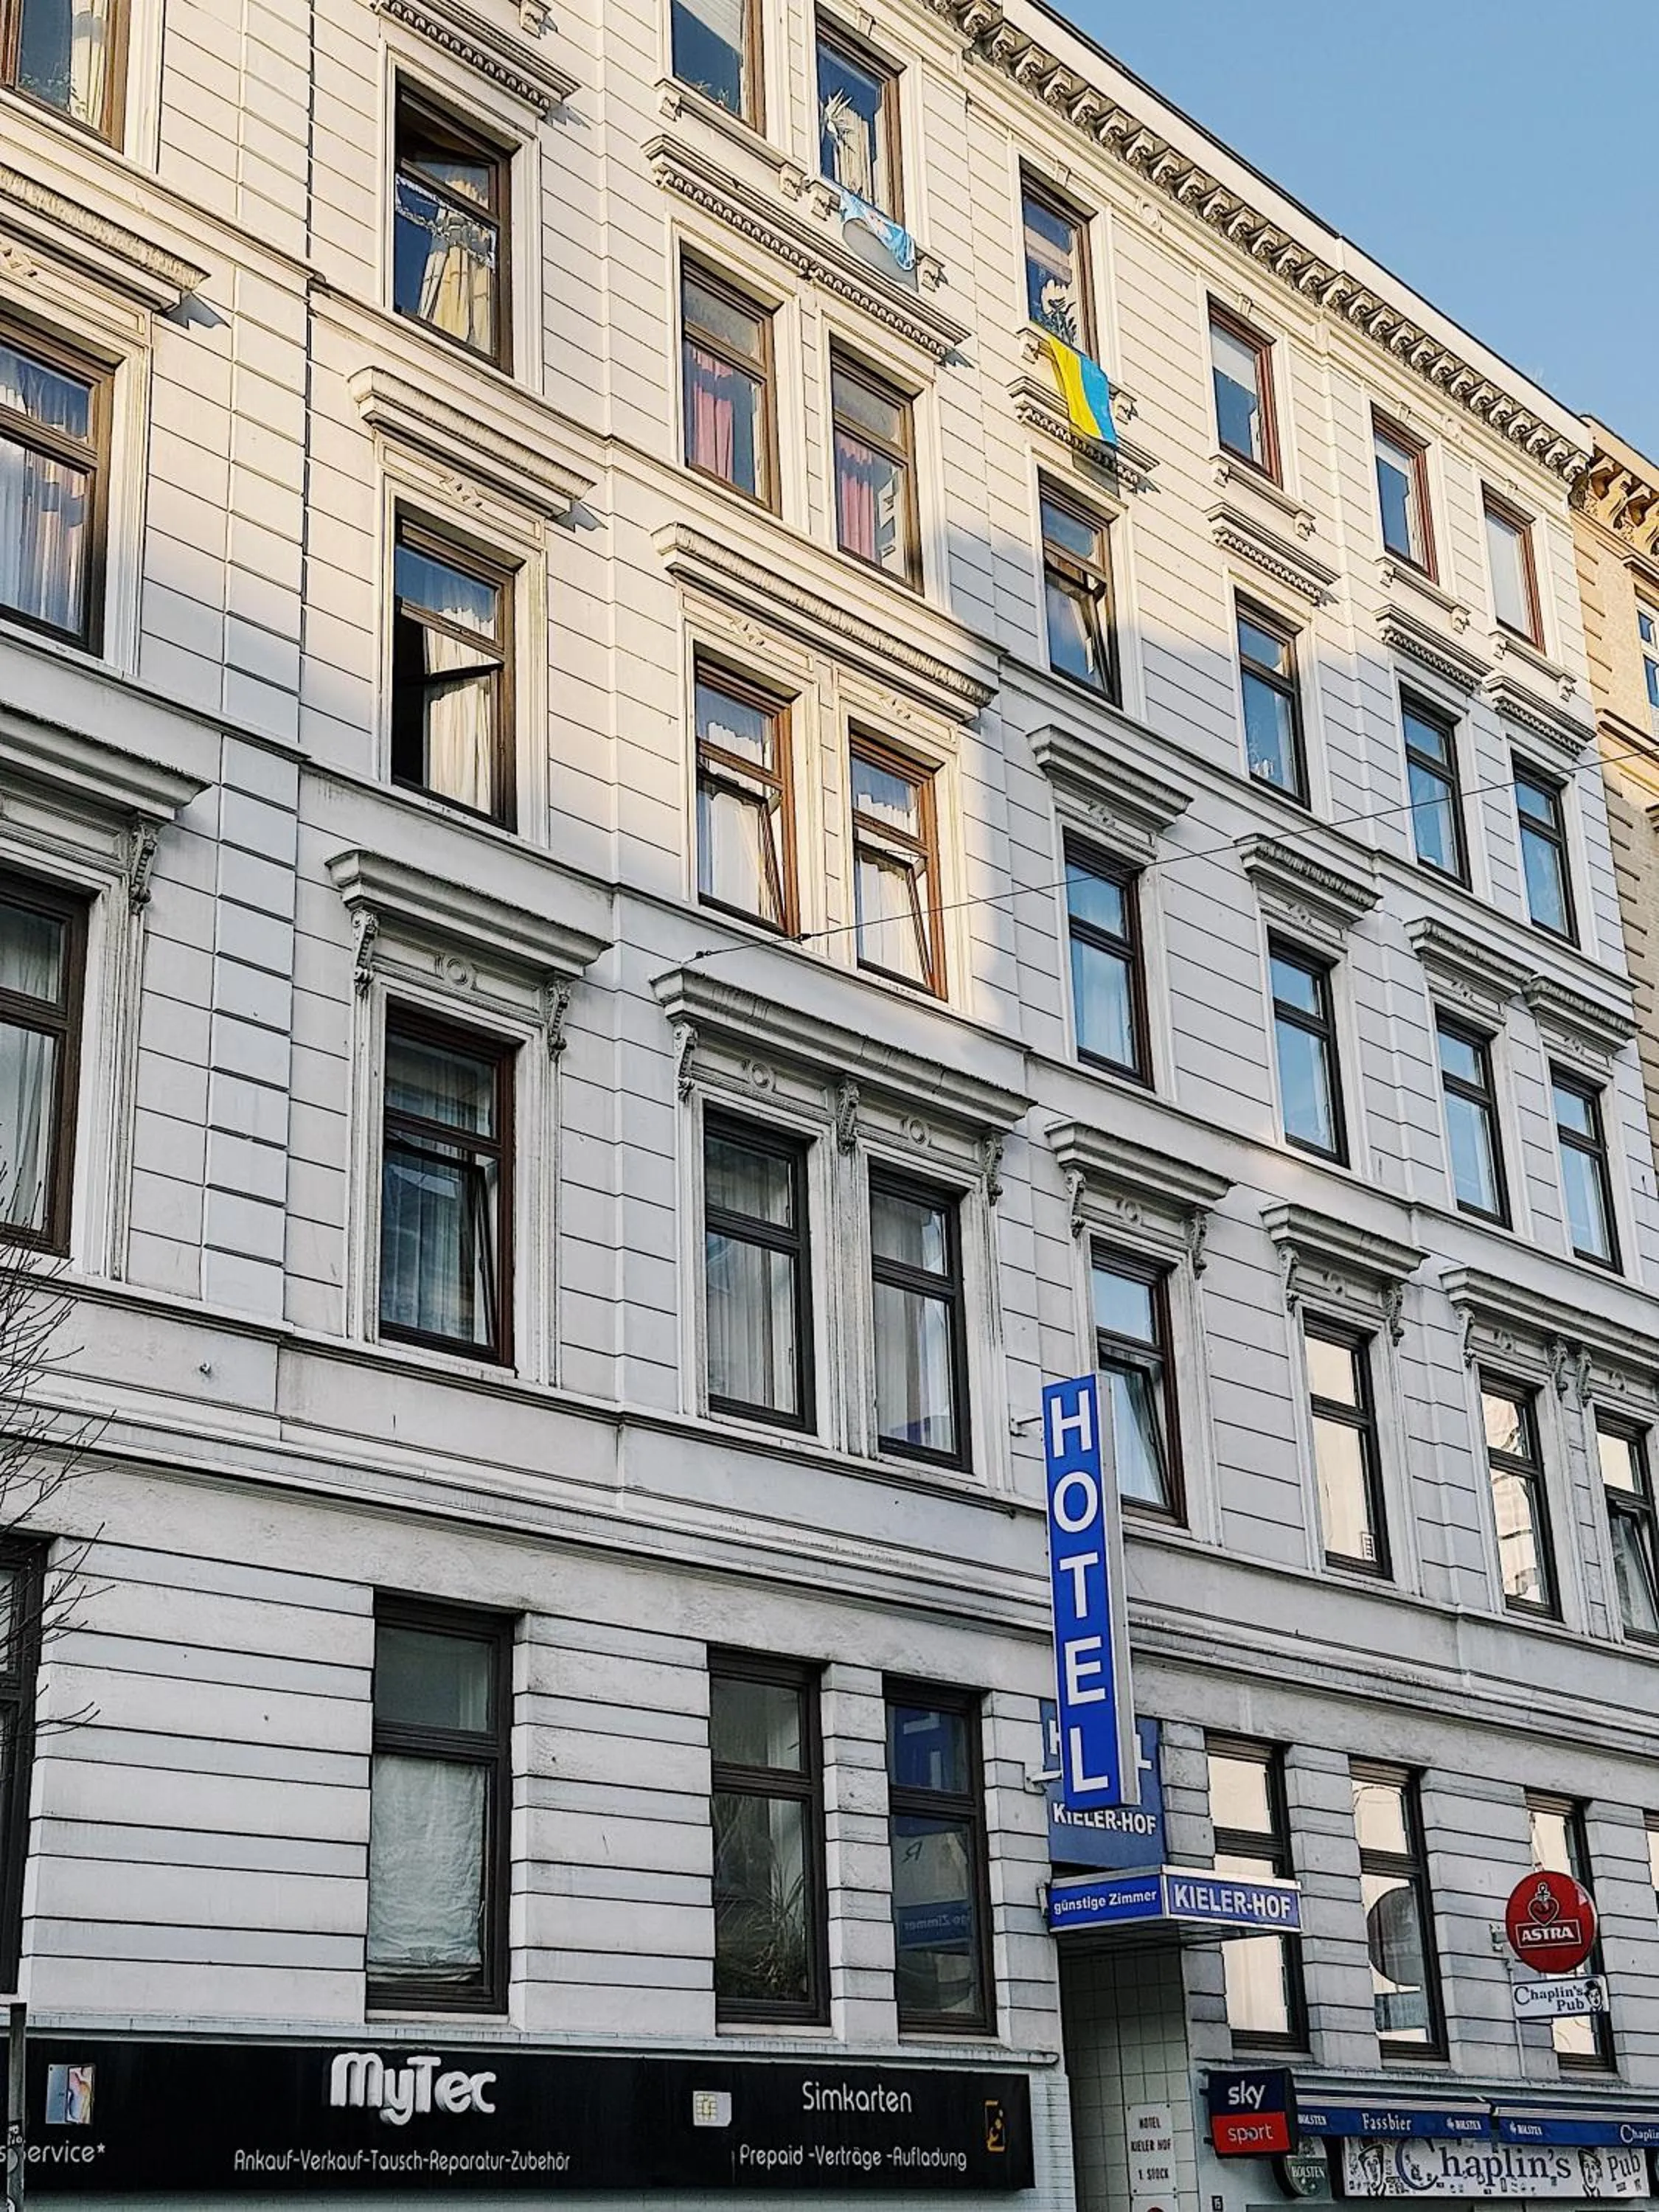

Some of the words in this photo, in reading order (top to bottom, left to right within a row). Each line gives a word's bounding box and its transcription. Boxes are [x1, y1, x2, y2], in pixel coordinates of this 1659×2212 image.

[1050, 1389, 1109, 1793] HOTEL
[1052, 1803, 1157, 1835] KIELER-HOF
[1054, 1896, 1106, 1916] günstige
[1108, 1890, 1157, 1907] Zimmer
[1174, 1883, 1292, 1919] KIELER-HOF
[1521, 1925, 1575, 1943] ASTRA
[1514, 1985, 1585, 2006] Chaplin's
[1557, 1997, 1585, 2012] Pub
[330, 2052, 496, 2126] MyTec
[802, 2080, 912, 2112] Simkarten
[1228, 2079, 1266, 2110] sky
[1228, 2122, 1274, 2145] sport
[1361, 2113, 1413, 2131] Fassbier
[740, 2143, 804, 2171] Prepaid
[1395, 2138, 1572, 2190] Chaplin's
[1607, 2149, 1641, 2182] Pub
[1147, 2166, 1169, 2180] STOCK
